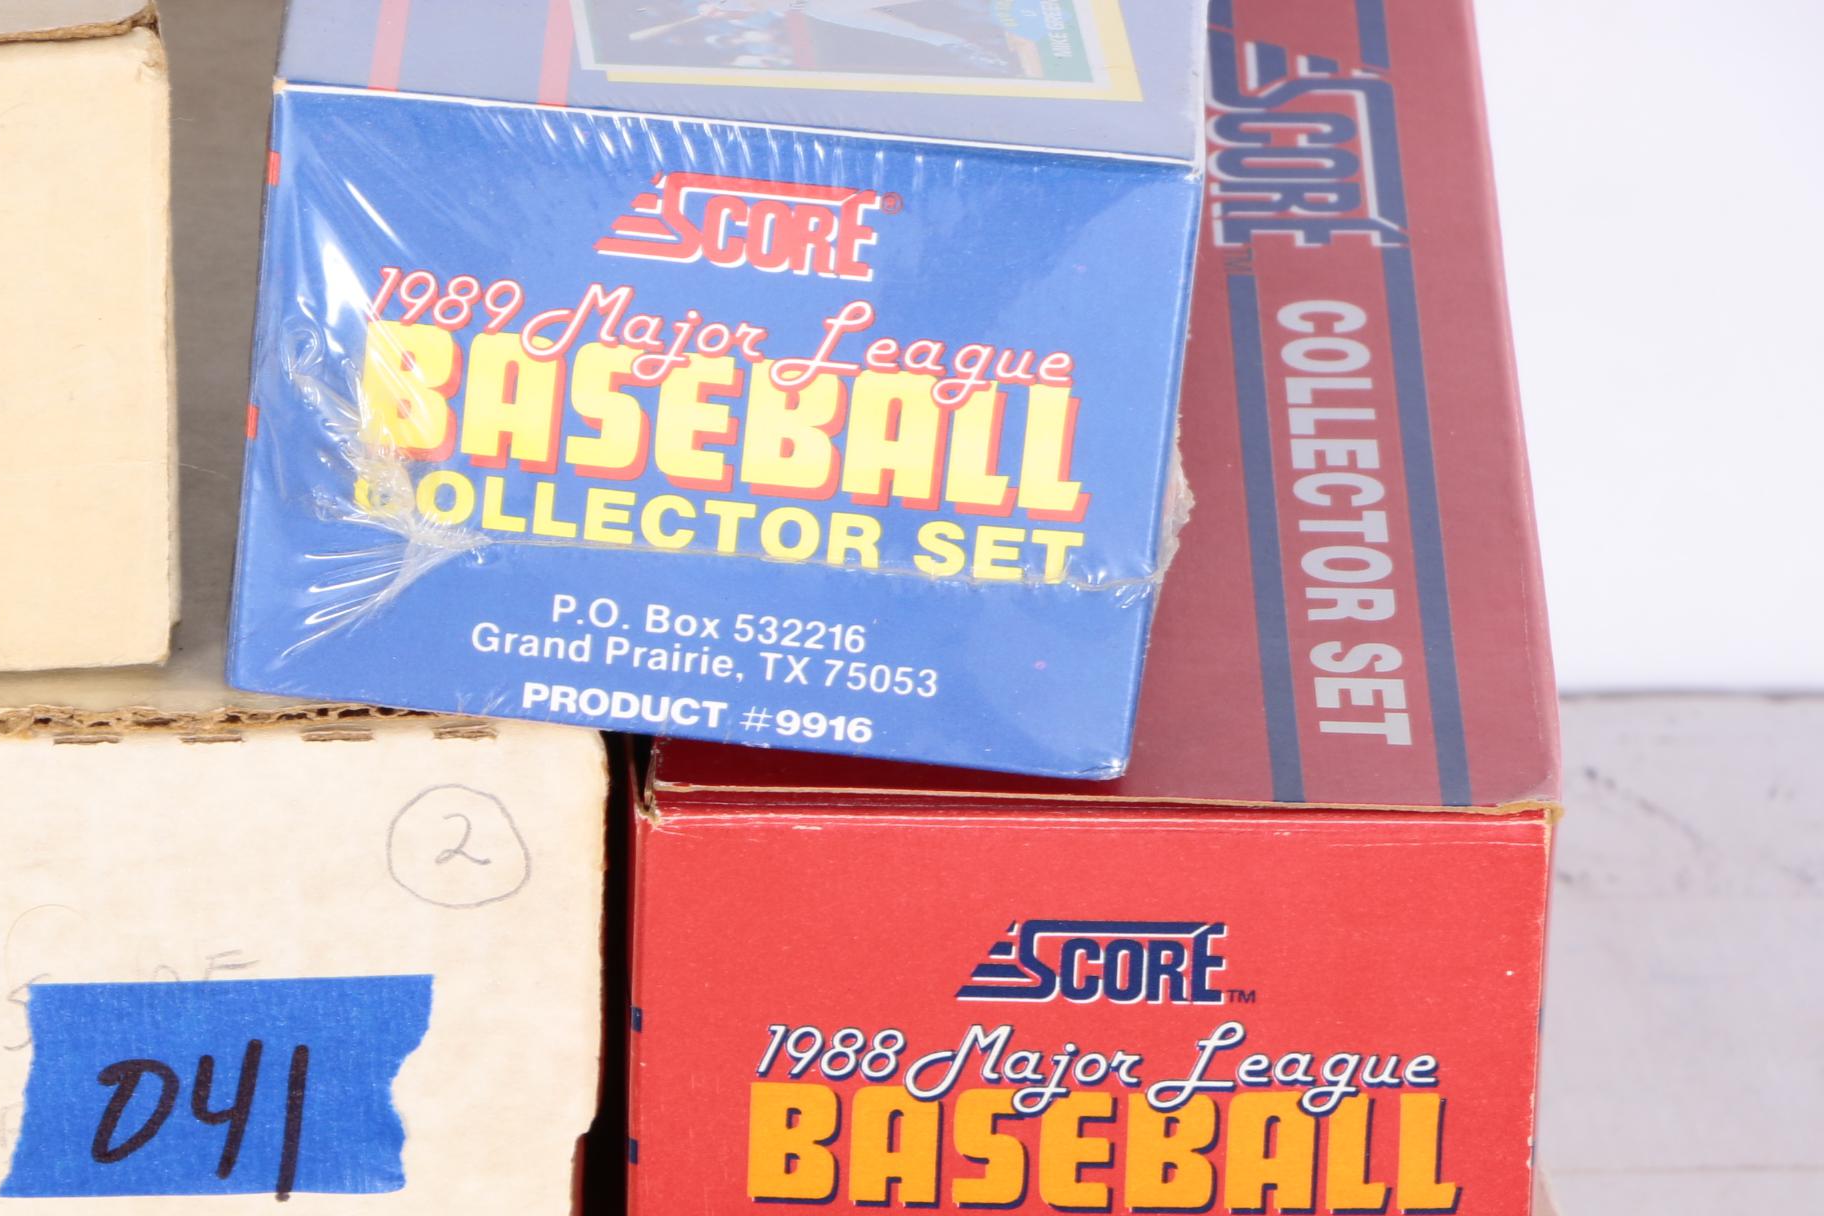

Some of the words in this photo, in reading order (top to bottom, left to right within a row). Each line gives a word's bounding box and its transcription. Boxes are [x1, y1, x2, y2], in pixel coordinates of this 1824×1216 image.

[1206, 25, 1411, 247] SCORE
[593, 171, 880, 282] SCORE
[368, 266, 524, 335] 1989
[521, 282, 768, 388] Major
[768, 299, 1074, 411] League
[362, 318, 1092, 523] BASEBALL
[1276, 299, 1398, 624] COLLECTOR
[912, 520, 1085, 585] SET
[471, 622, 591, 664] Grand
[605, 636, 745, 683] Prairie,
[760, 651, 809, 686] TX
[823, 659, 939, 698] 75053
[552, 593, 628, 630] P.O.
[645, 603, 720, 640] Box
[732, 613, 867, 655] 532216
[522, 681, 728, 730] PRODUCT
[739, 705, 874, 744] #9916
[1309, 641, 1413, 746] SET
[955, 918, 1228, 1006] SCORE
[91, 1038, 309, 1203] 041
[756, 1023, 903, 1082] 1988
[903, 1023, 1143, 1114] Major
[1146, 1020, 1439, 1115] League
[746, 1082, 1464, 1216] BASEBALL
